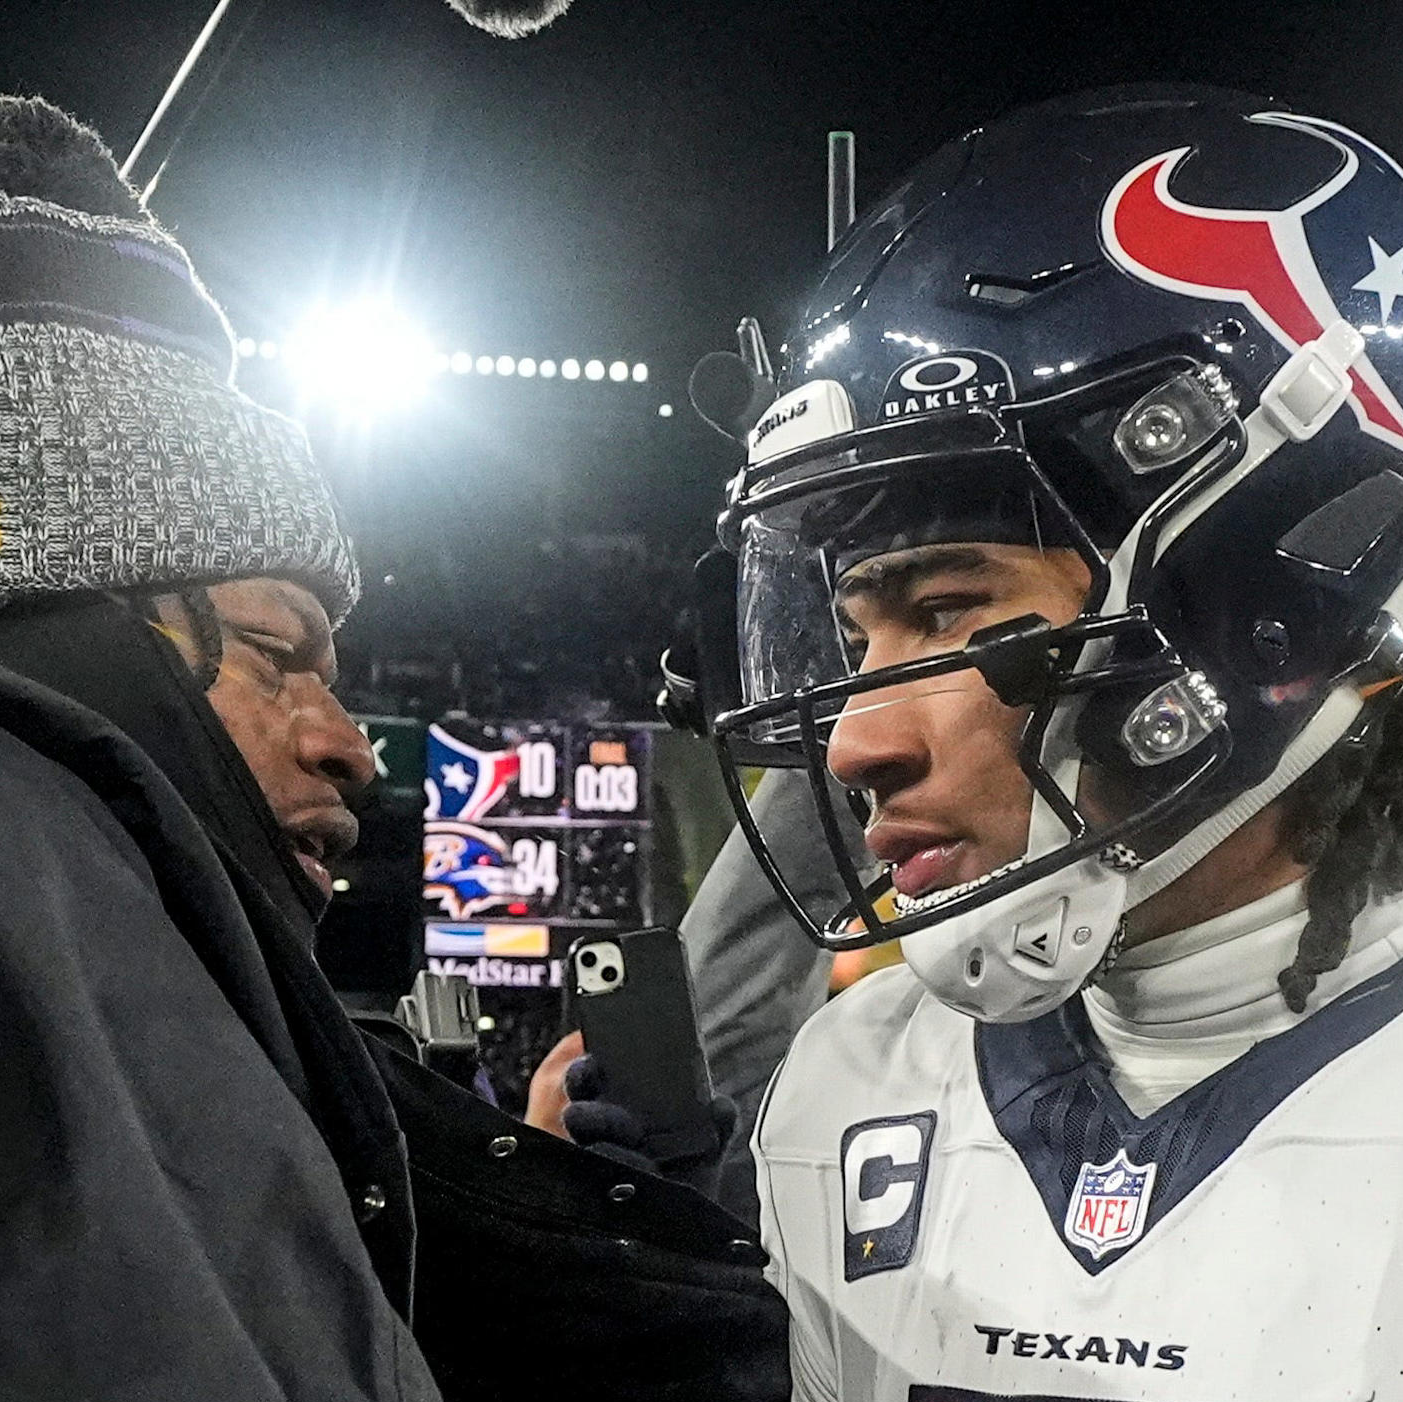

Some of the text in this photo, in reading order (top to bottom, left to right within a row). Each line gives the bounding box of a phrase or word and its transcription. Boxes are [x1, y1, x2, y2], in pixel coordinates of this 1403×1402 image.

[885, 382, 1002, 418] OAKLEY
[517, 741, 557, 798] 10
[511, 838, 560, 896] 34
[844, 1124, 923, 1235] C
[1079, 1198, 1131, 1238] NFL
[974, 1324, 1190, 1371] TEXANS
